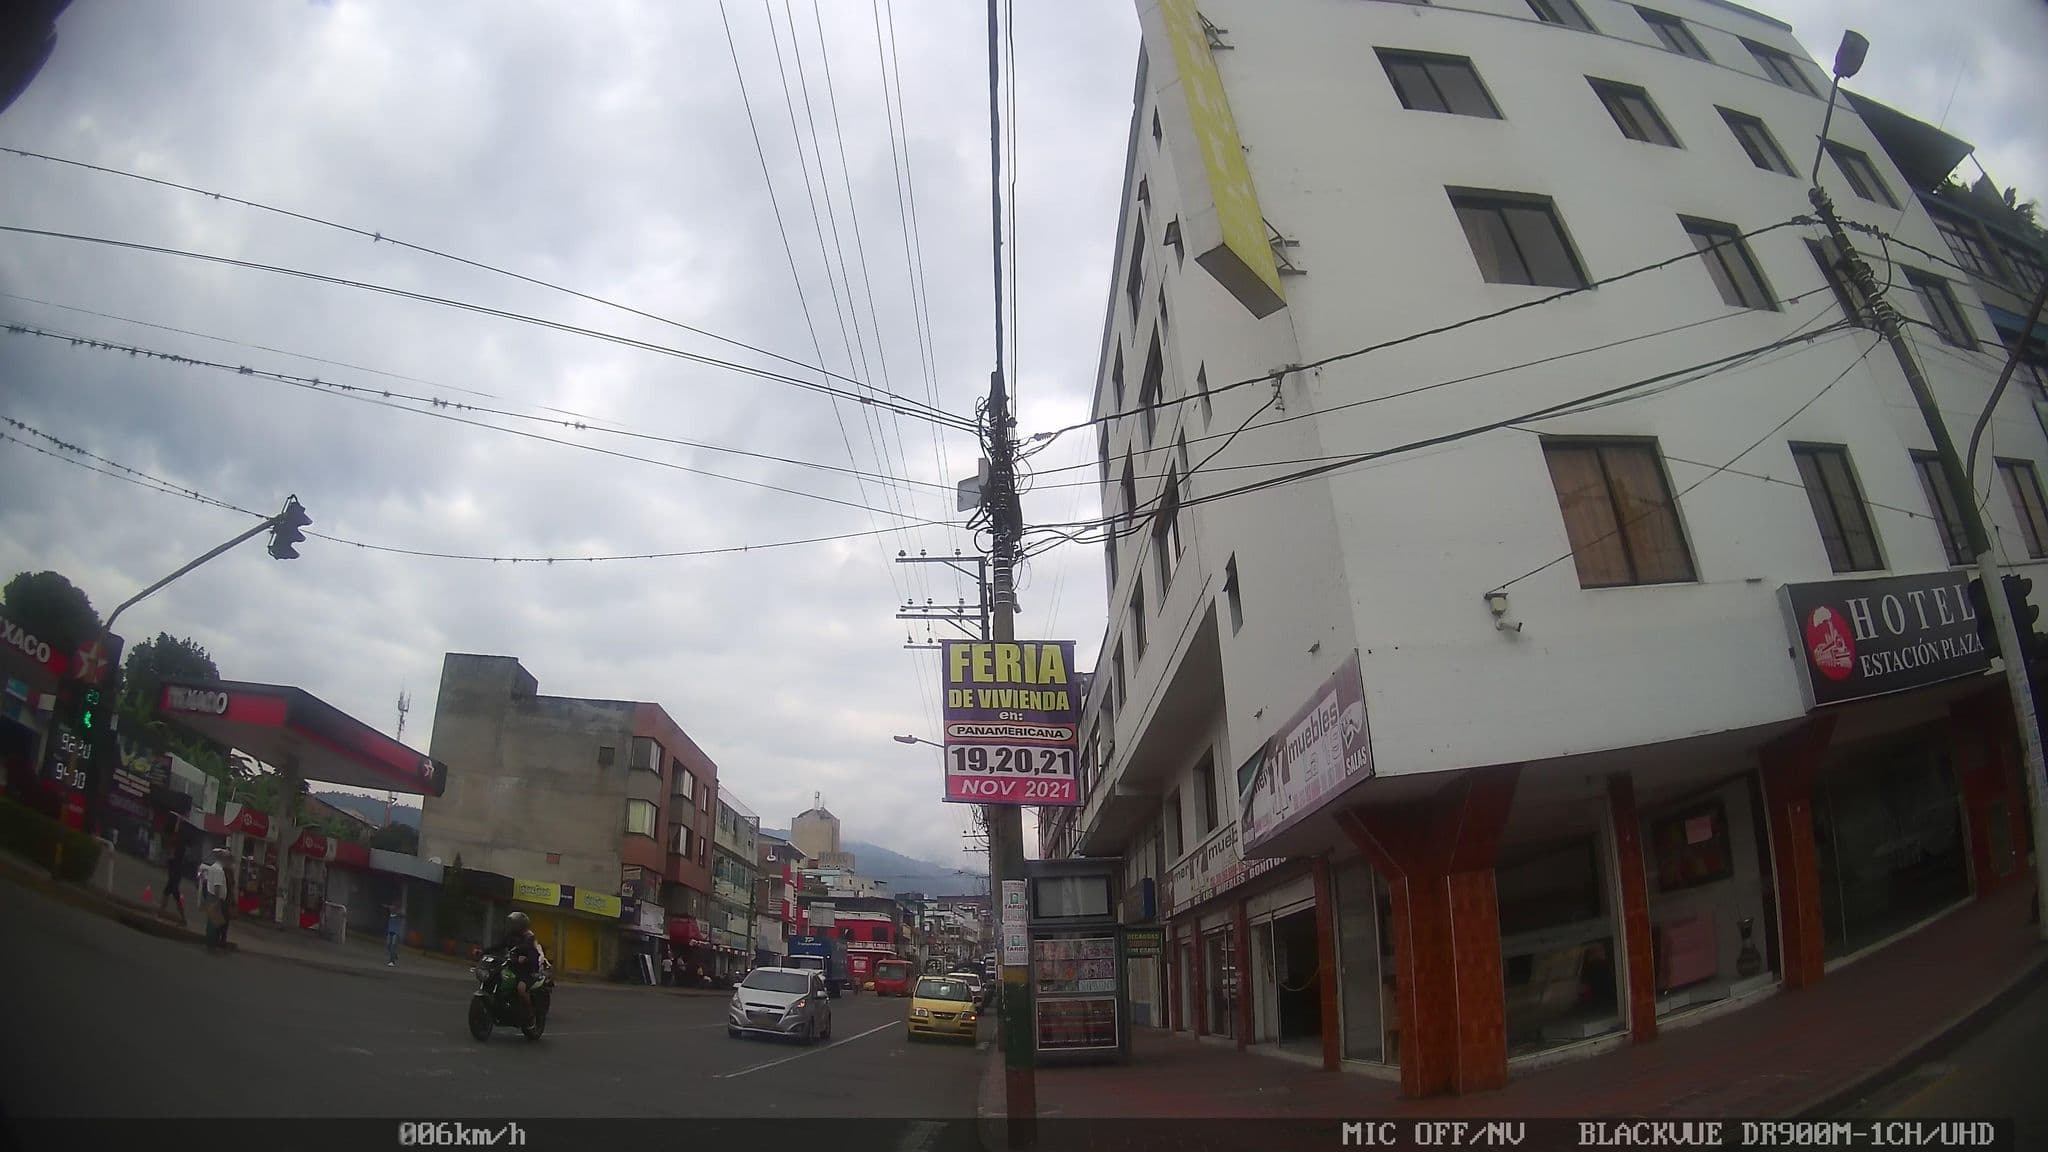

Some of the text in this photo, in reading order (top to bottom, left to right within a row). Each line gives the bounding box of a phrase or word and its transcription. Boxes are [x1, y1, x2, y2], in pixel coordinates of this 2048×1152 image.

[1845, 583, 1976, 641] HOTEL
[949, 643, 1068, 685] FERIA
[1859, 631, 1985, 678] ESTACIÓN PLAZA
[948, 689, 1070, 711] DE VIVIENDA
[999, 711, 1024, 721] en:
[957, 726, 1064, 739] PANAMERICANA
[1288, 702, 1338, 764] muebles
[951, 747, 1072, 776] 19,20,21
[1345, 745, 1368, 776] SALAS
[961, 779, 1071, 798] NOV 2021
